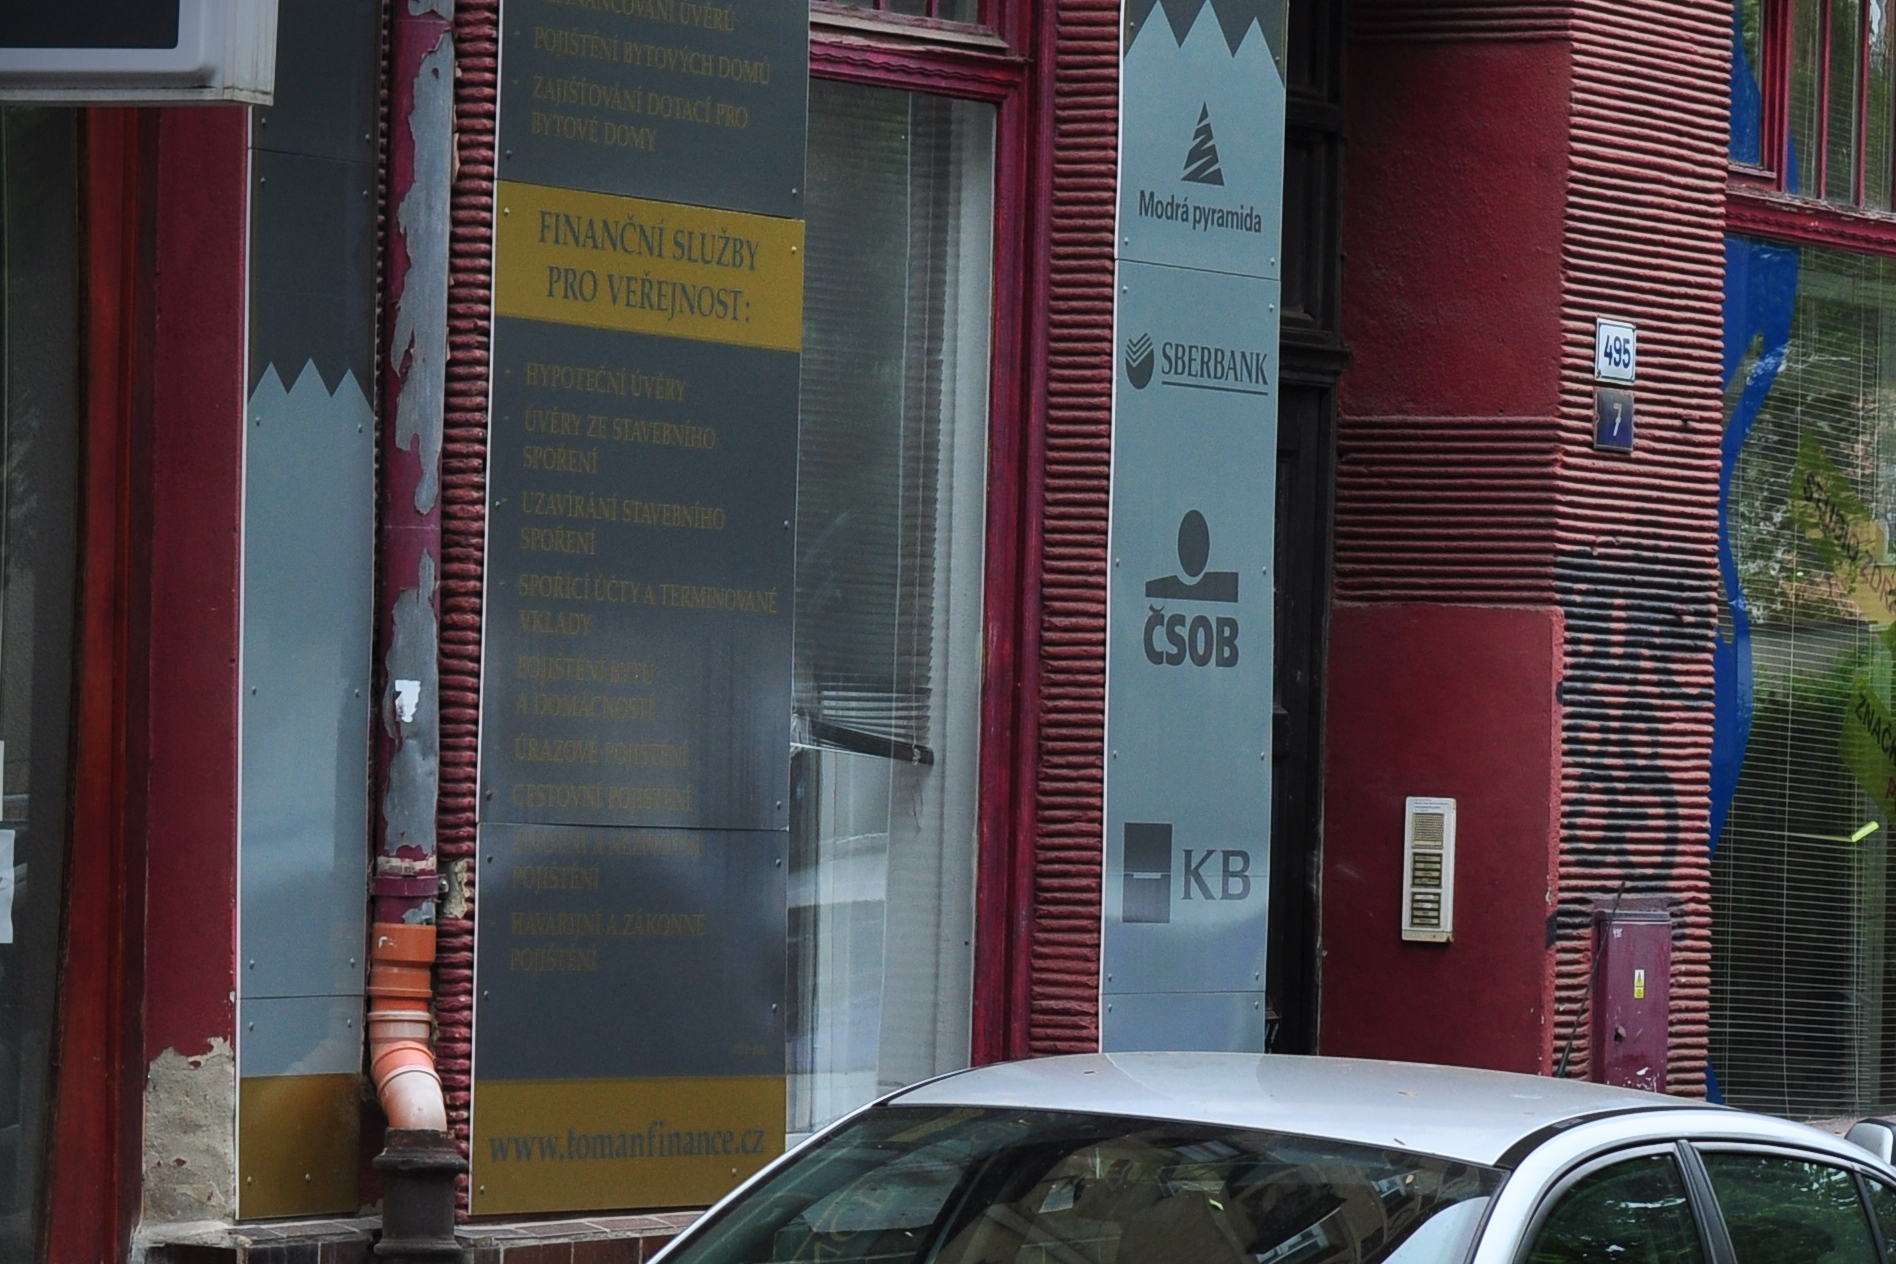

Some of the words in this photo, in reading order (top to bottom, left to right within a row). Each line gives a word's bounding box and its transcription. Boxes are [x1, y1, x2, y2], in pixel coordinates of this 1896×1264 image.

[533, 25, 619, 61] POJIŠTĚNÍ
[622, 40, 714, 77] BYTOVÝCH
[718, 55, 772, 86] DOMŮ
[531, 111, 599, 143] BYTOVÉ
[604, 122, 657, 151] DOMY
[647, 92, 712, 125] DOTACÍ
[715, 102, 749, 129] PRO
[1138, 190, 1190, 223] Modrá
[1192, 203, 1262, 233] pyramida
[538, 210, 667, 259] FINANČNÍ
[673, 227, 760, 271] SLUŽBY
[547, 265, 598, 302] PRO
[607, 271, 751, 323] VEŘEJNOST:
[1161, 341, 1269, 386] SBERBANK
[1603, 335, 1631, 369] 495
[525, 361, 626, 396] HYPOTEČNÍ
[631, 368, 687, 402] ÚVĚRY
[524, 403, 581, 437] ÚVĚRY
[586, 415, 607, 440] ZE
[612, 417, 719, 450] STAVEBNÍHO
[1612, 402, 1623, 437] 7
[522, 444, 599, 475] SPOŘENÍ
[622, 498, 727, 532] STAVEBNÍHO
[519, 525, 597, 555] SPOŘENÍ
[644, 582, 656, 607] A
[517, 608, 592, 637] VKLADY
[1143, 603, 1240, 668] ČSOB
[1180, 848, 1252, 900] KB
[488, 1119, 766, 1163] www.tomanfinance.cz
